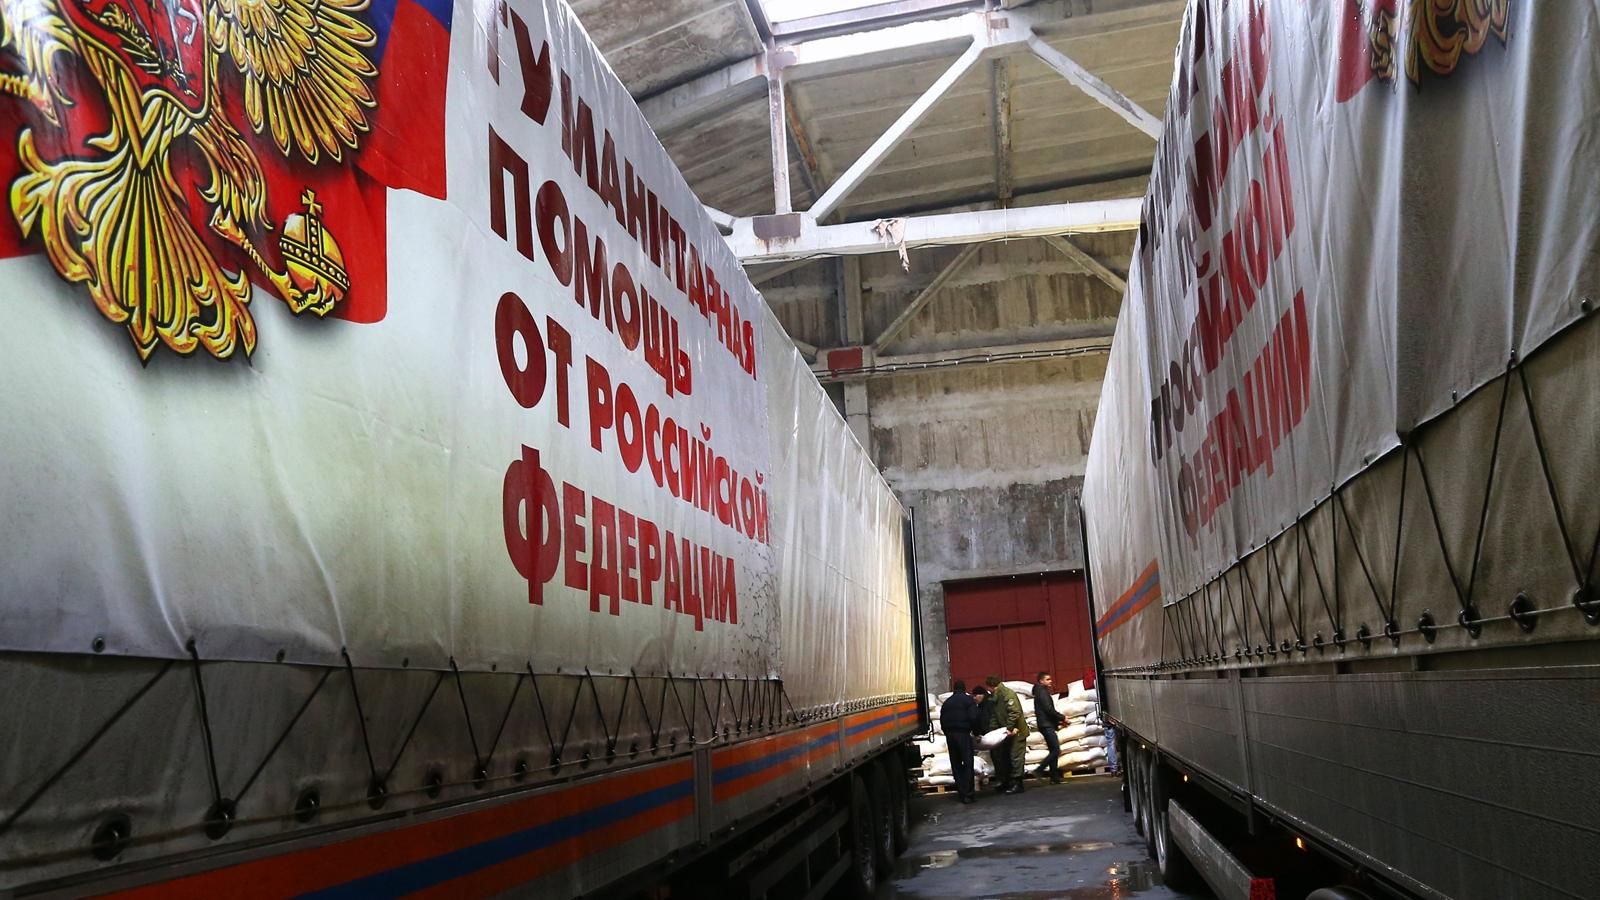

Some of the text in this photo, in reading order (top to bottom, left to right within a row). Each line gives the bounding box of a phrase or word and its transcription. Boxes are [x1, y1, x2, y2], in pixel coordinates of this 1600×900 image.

[487, 0, 757, 381] ГУМАНИТАРНАЯ
[488, 122, 692, 399] ПОМОЩЬ
[495, 291, 770, 546] ОТ РОССИЙСКОЙ
[502, 443, 738, 632] ФЕДЕРАЦИИ
